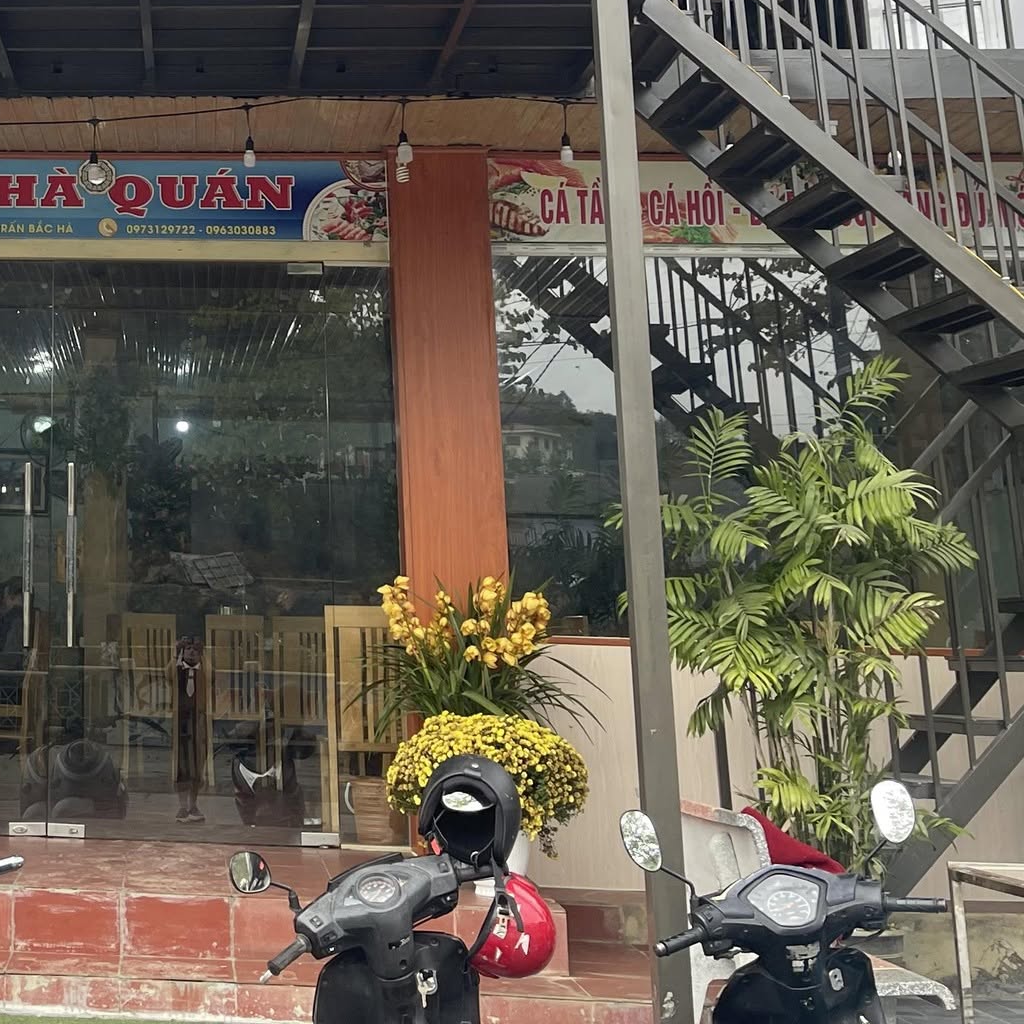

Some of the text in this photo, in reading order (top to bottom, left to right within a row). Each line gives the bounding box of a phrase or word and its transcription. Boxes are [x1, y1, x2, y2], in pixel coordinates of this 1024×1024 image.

[107, 167, 295, 216] QUÁN
[540, 182, 570, 225] CÁ
[576, 177, 605, 225] TẦ
[649, 183, 680, 226] CÁ
[686, 176, 726, 226] HỒI
[126, 225, 196, 235] 0973129722
[205, 225, 276, 236] 0963030883
